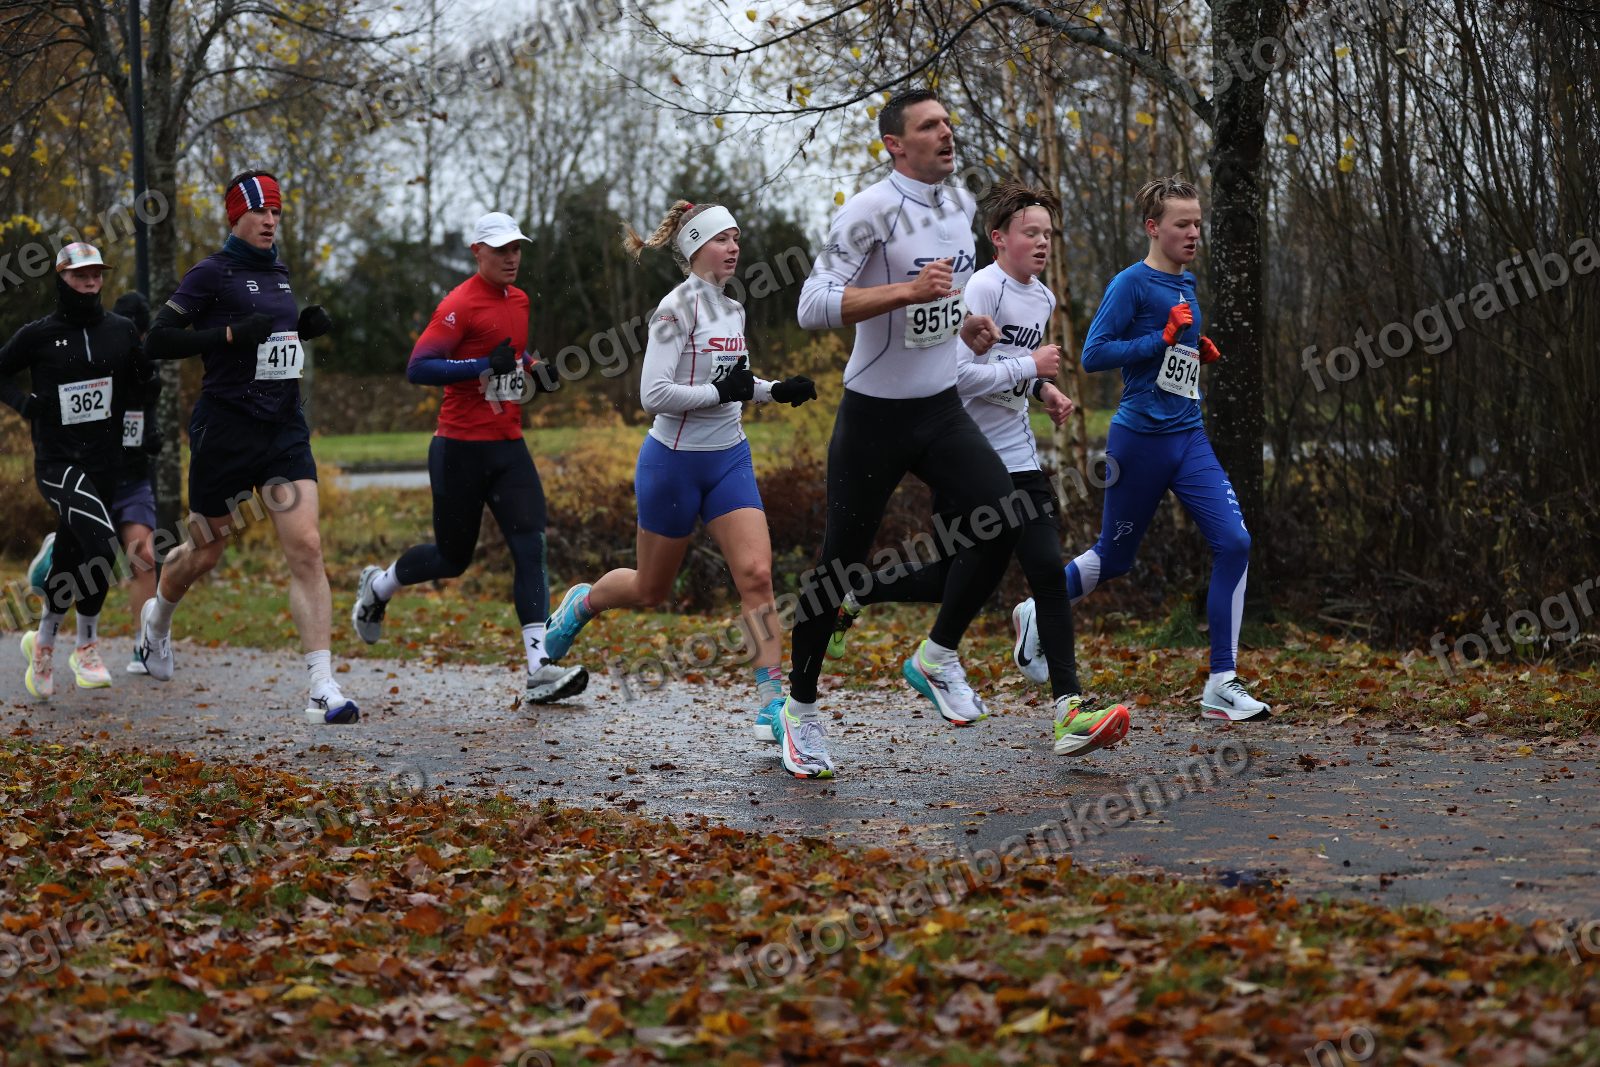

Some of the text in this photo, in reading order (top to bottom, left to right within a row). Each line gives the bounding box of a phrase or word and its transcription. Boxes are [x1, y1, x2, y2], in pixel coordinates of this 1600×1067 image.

[912, 300, 962, 335] 9515
[267, 344, 297, 368] 417
[1165, 355, 1198, 387] 9514
[70, 390, 104, 413] 362
